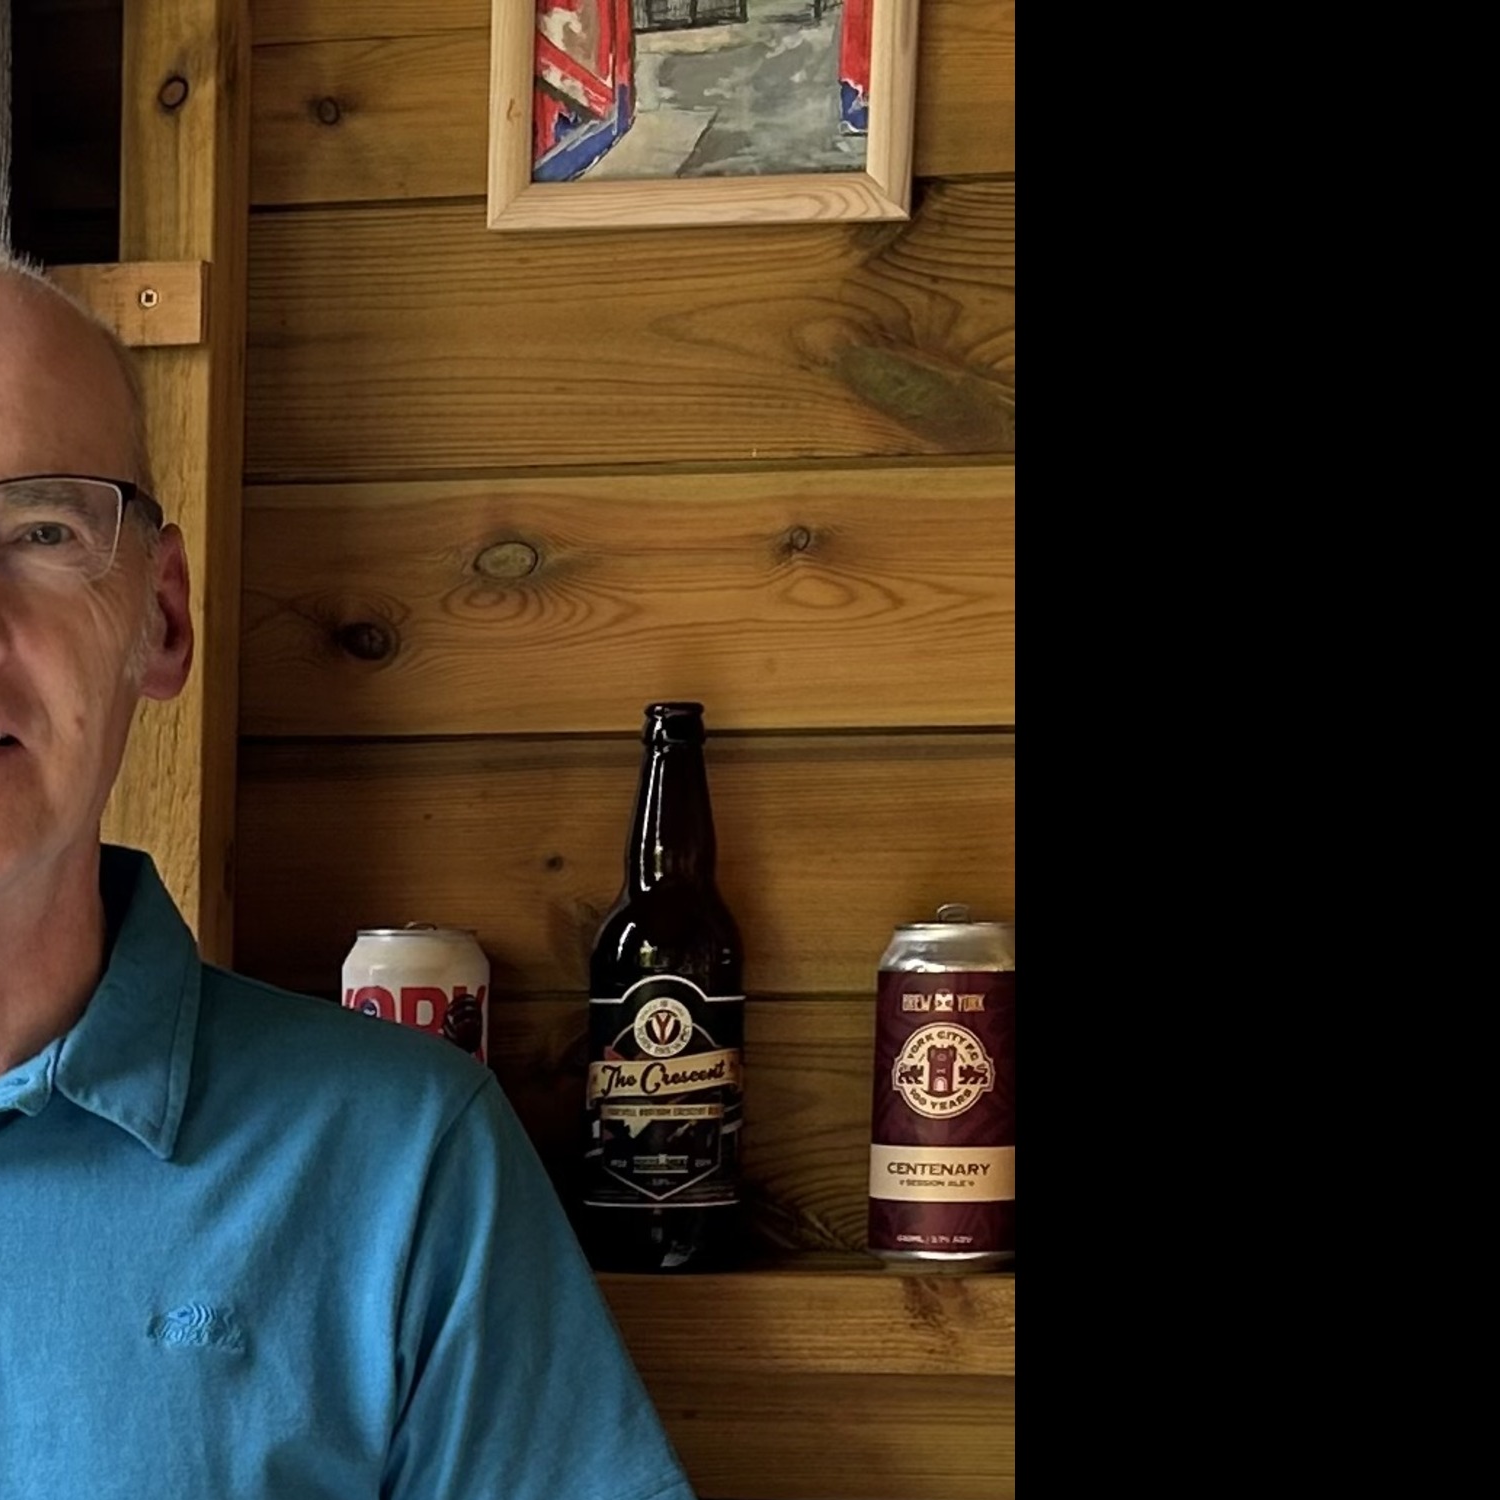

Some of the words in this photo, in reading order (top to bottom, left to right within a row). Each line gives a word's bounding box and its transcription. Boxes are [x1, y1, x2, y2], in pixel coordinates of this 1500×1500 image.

[907, 1032, 934, 1059] YORK
[936, 1030, 967, 1046] CITY
[601, 1063, 637, 1096] The
[639, 1059, 726, 1095] Crescent
[930, 1088, 973, 1110] YEARS
[887, 1161, 991, 1176] CENTENARY
